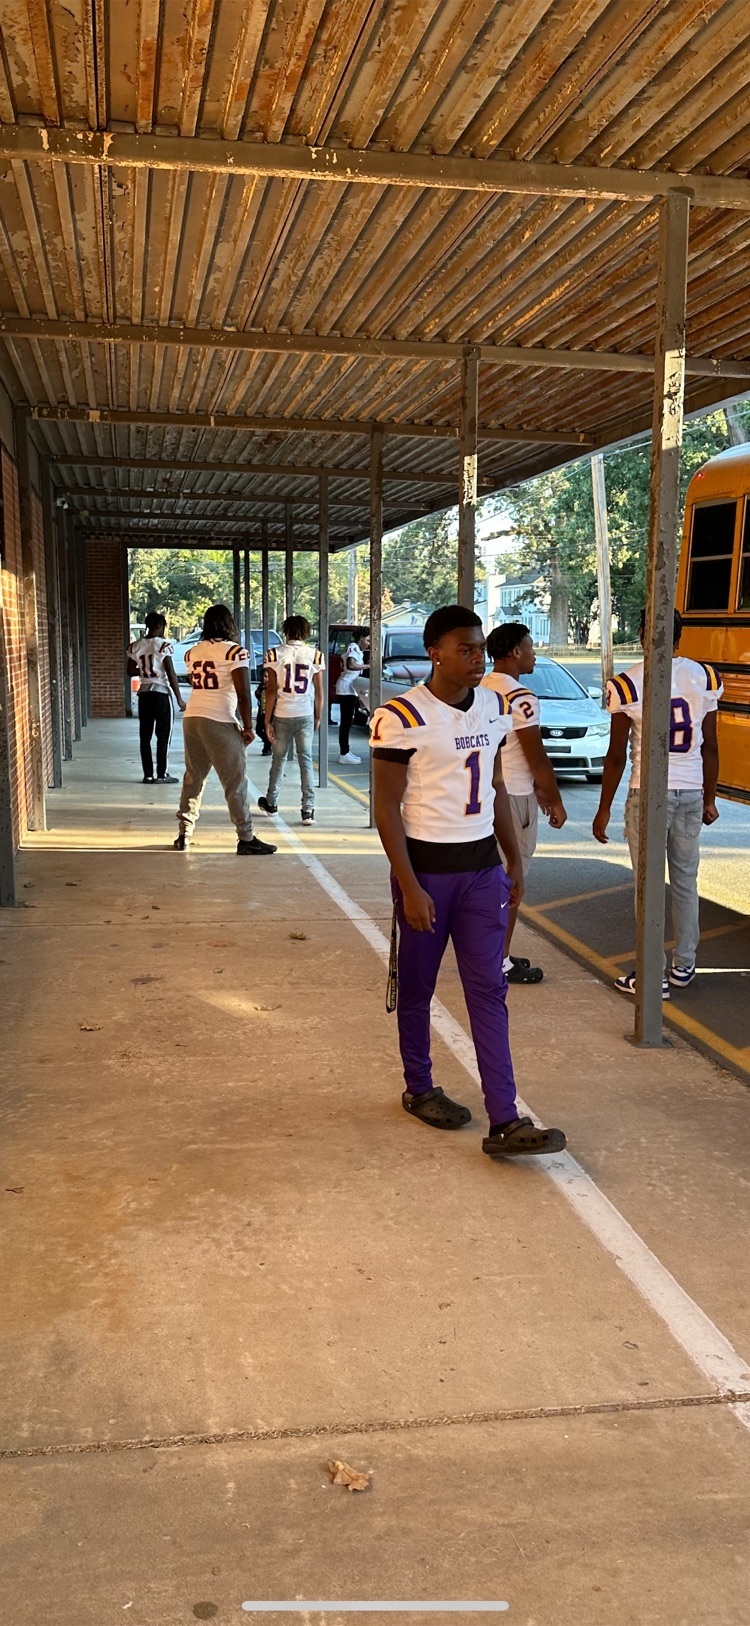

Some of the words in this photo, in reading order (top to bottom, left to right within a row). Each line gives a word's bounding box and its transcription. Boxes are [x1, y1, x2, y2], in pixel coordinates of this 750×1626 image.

[139, 654, 158, 678] 11
[282, 663, 310, 694] 15
[519, 701, 534, 719] 2
[373, 713, 385, 742] 1
[454, 733, 491, 751] BOBCATS
[464, 750, 483, 817] 1
